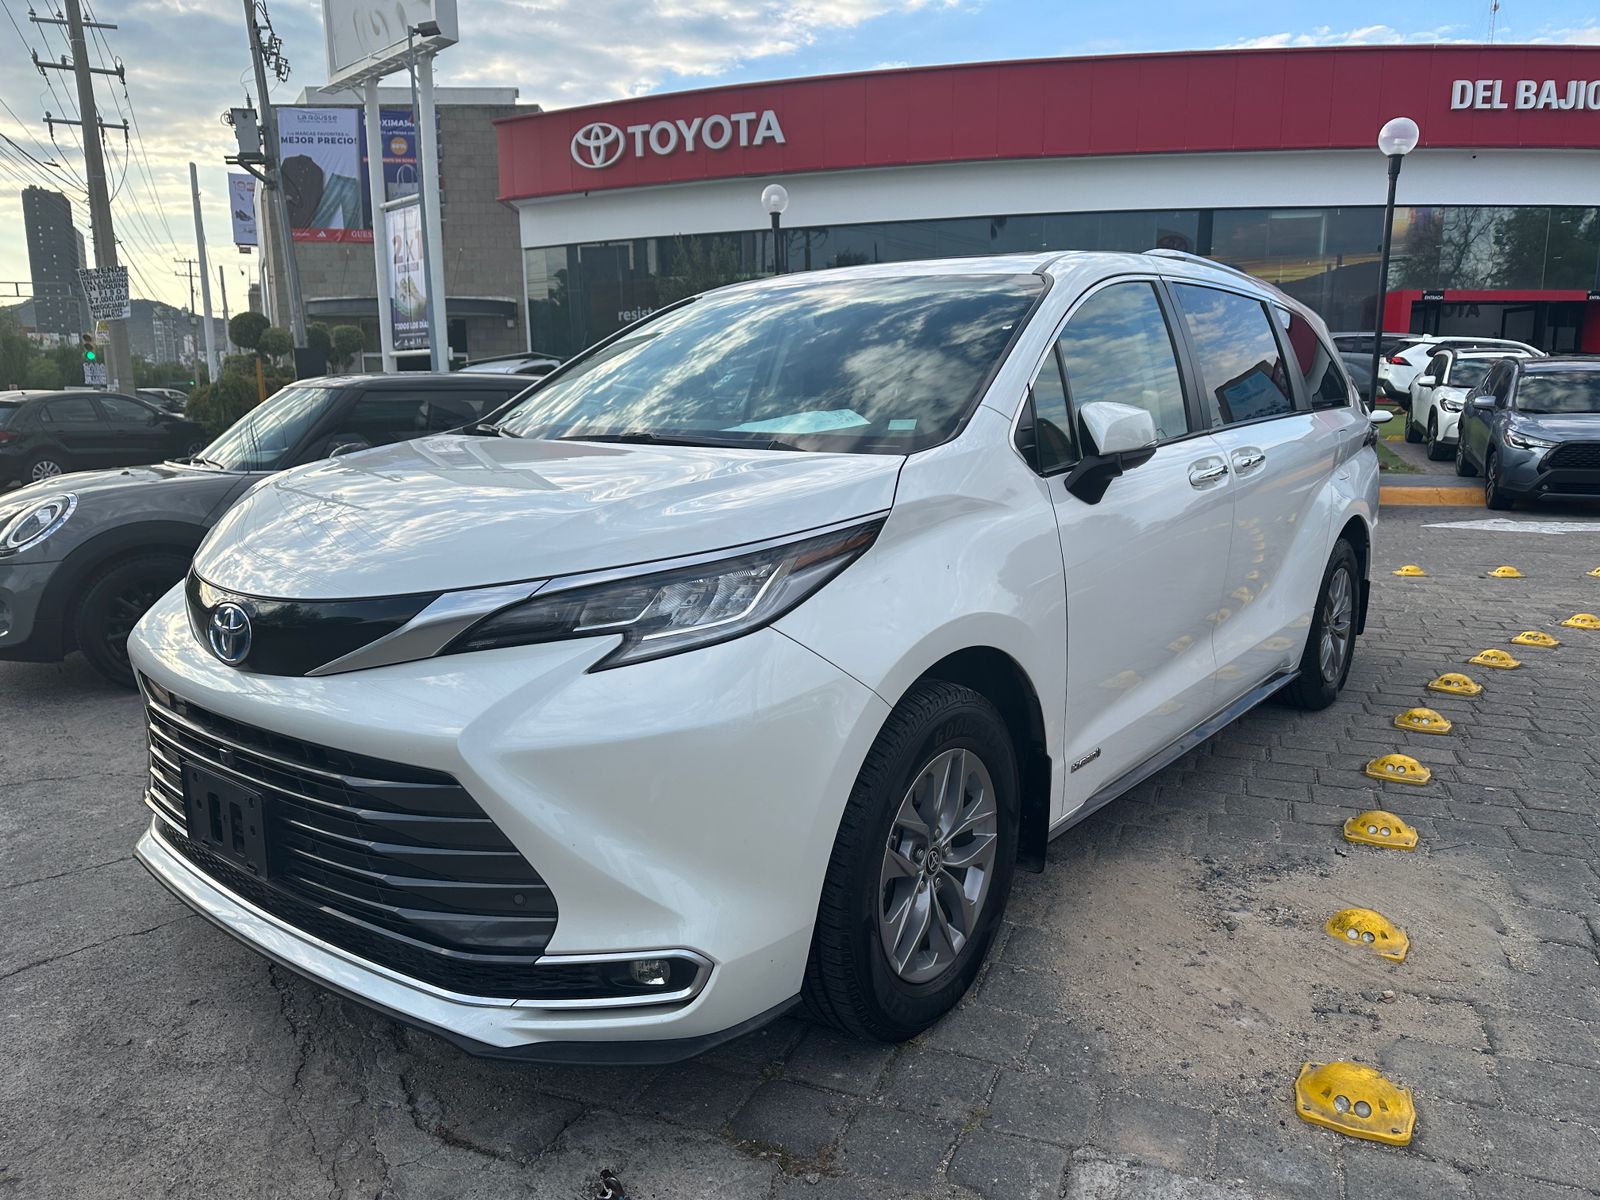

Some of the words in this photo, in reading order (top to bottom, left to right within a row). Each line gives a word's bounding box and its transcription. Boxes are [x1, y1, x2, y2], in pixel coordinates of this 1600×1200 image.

[1451, 79, 1508, 110] DEL
[1514, 79, 1600, 110] BAJIO
[627, 110, 786, 157] TOYOTA
[280, 136, 314, 144] MEJOR
[317, 137, 357, 145] PRECIO!
[95, 265, 128, 274] VENDE
[97, 282, 129, 290] ESQUINA
